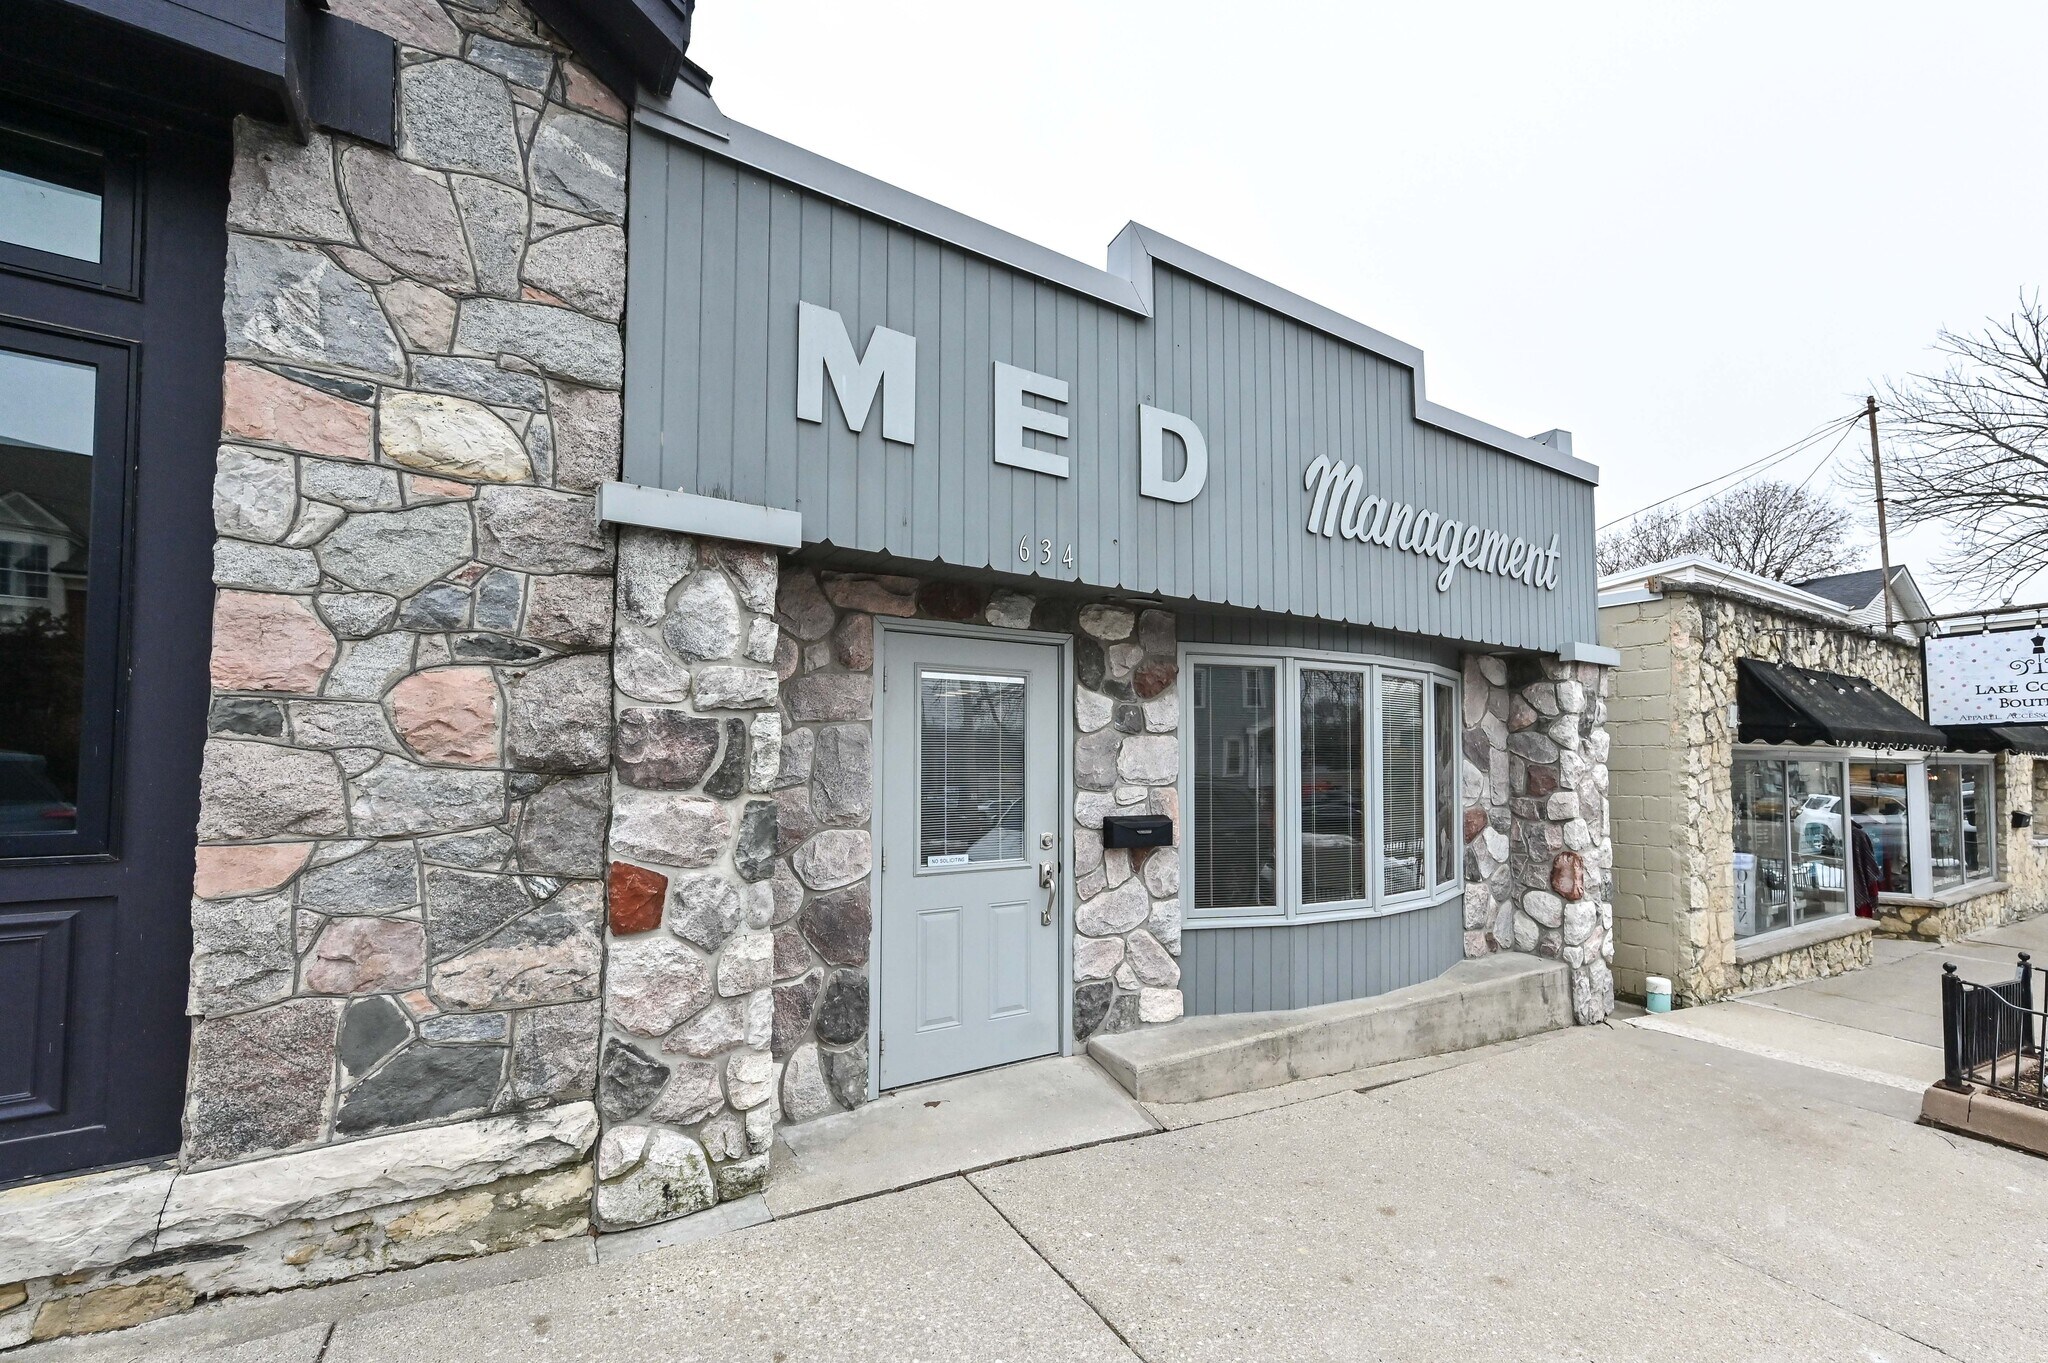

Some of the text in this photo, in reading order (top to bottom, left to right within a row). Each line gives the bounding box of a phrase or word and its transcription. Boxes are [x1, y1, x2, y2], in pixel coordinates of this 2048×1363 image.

[1304, 453, 1561, 592] Management
[1019, 534, 1073, 569] 634
[1975, 685, 2018, 695] LAKE
